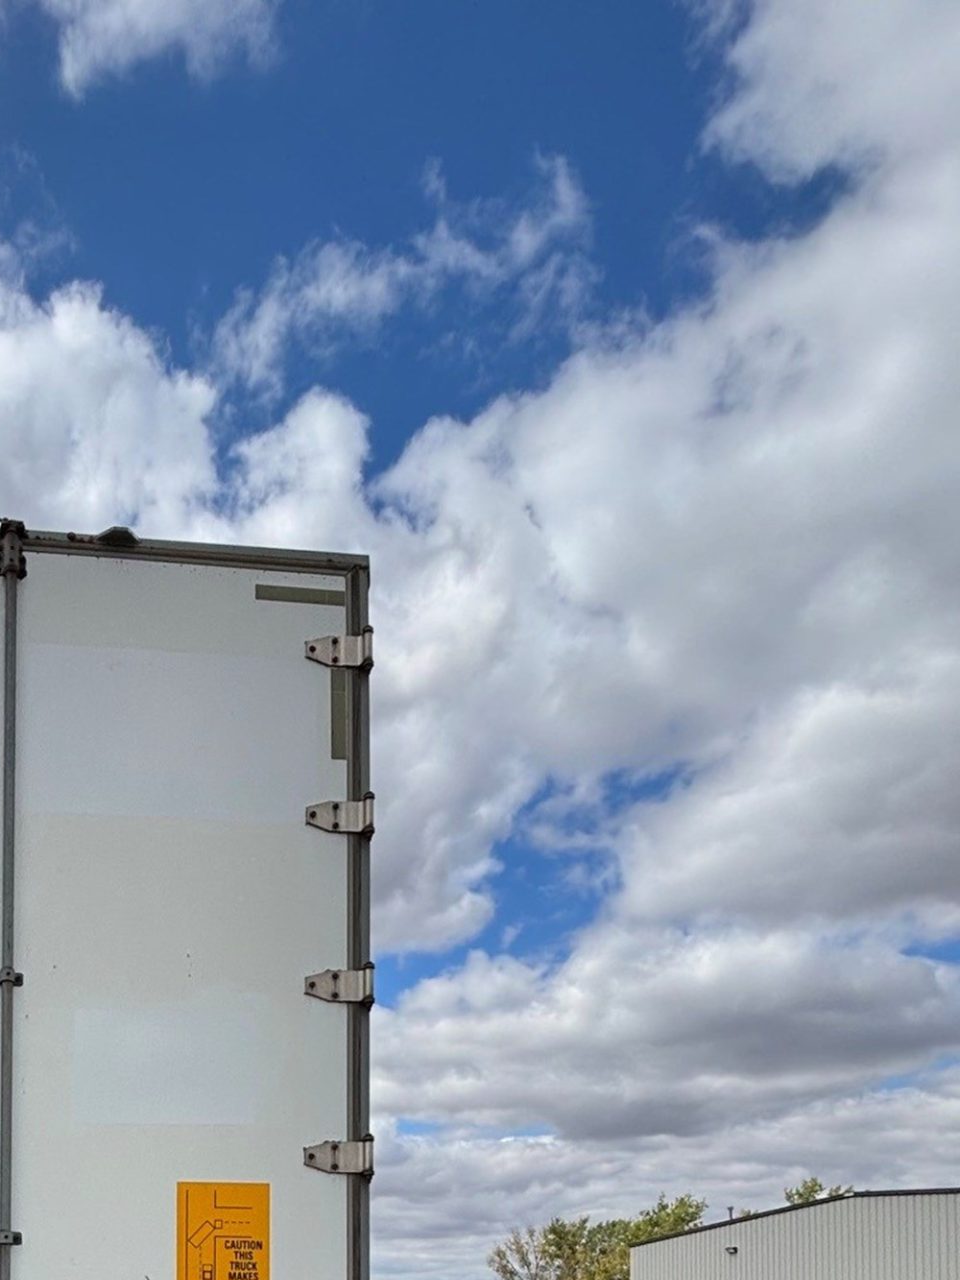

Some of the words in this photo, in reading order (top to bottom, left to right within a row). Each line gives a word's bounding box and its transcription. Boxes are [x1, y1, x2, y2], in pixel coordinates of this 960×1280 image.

[224, 1240, 263, 1250] CAUTION
[233, 1250, 254, 1260] THIS
[229, 1261, 257, 1271] TRUCK
